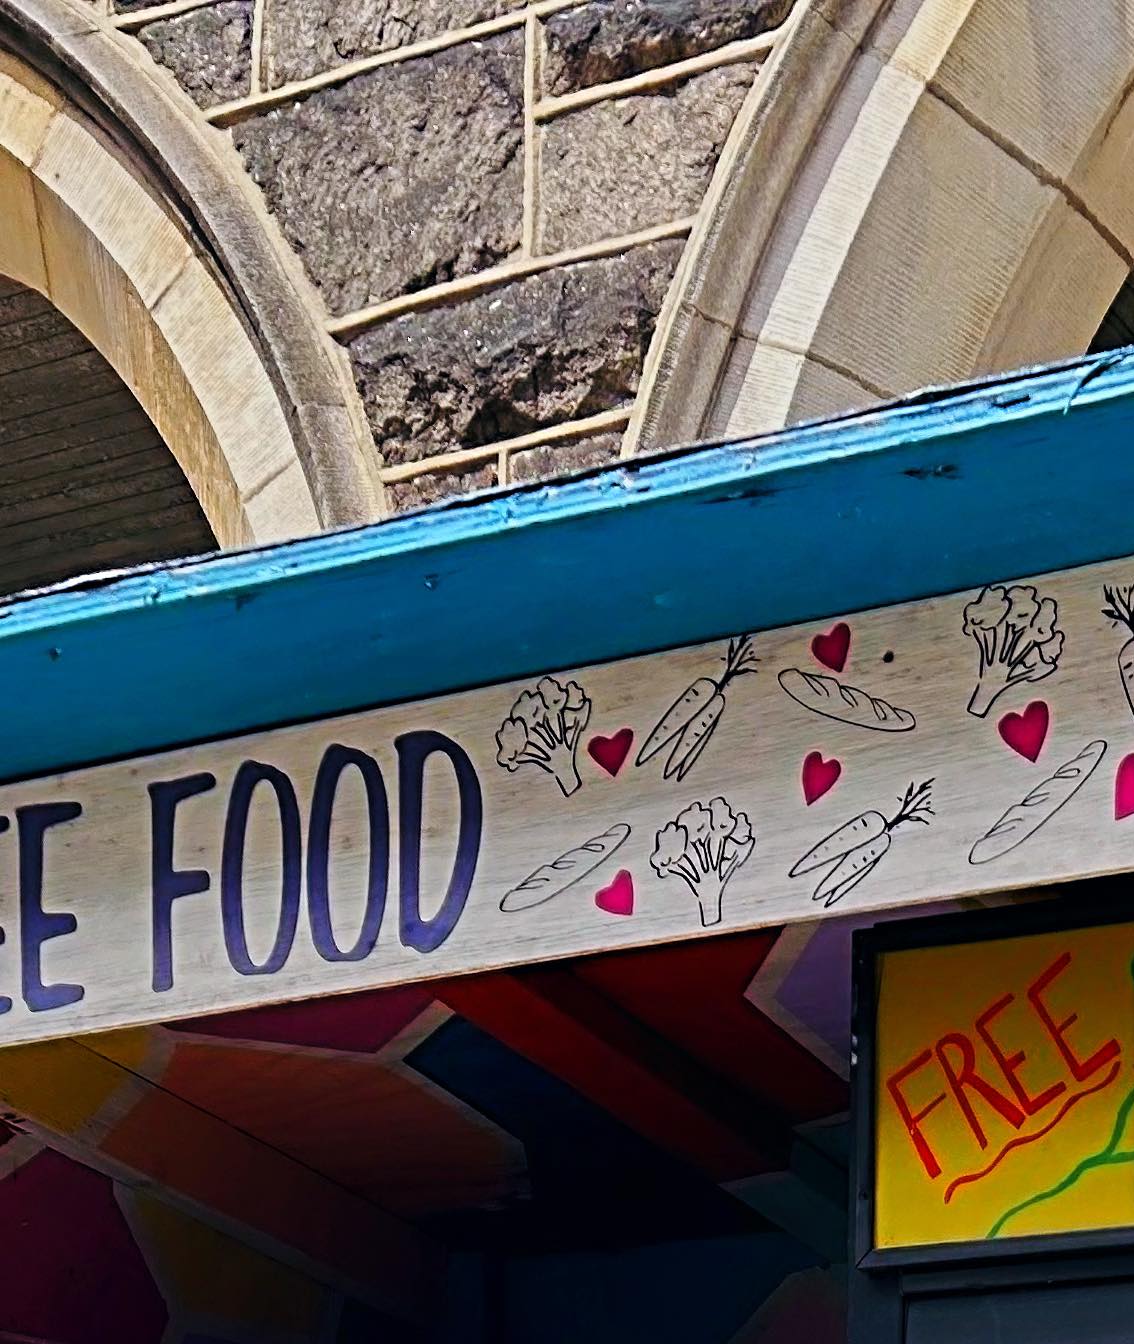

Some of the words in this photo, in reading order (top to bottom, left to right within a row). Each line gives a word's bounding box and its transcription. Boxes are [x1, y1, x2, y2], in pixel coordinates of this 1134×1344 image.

[0, 801, 85, 1013] E
[147, 729, 484, 993] FOOD
[886, 952, 1122, 1180] FREE
